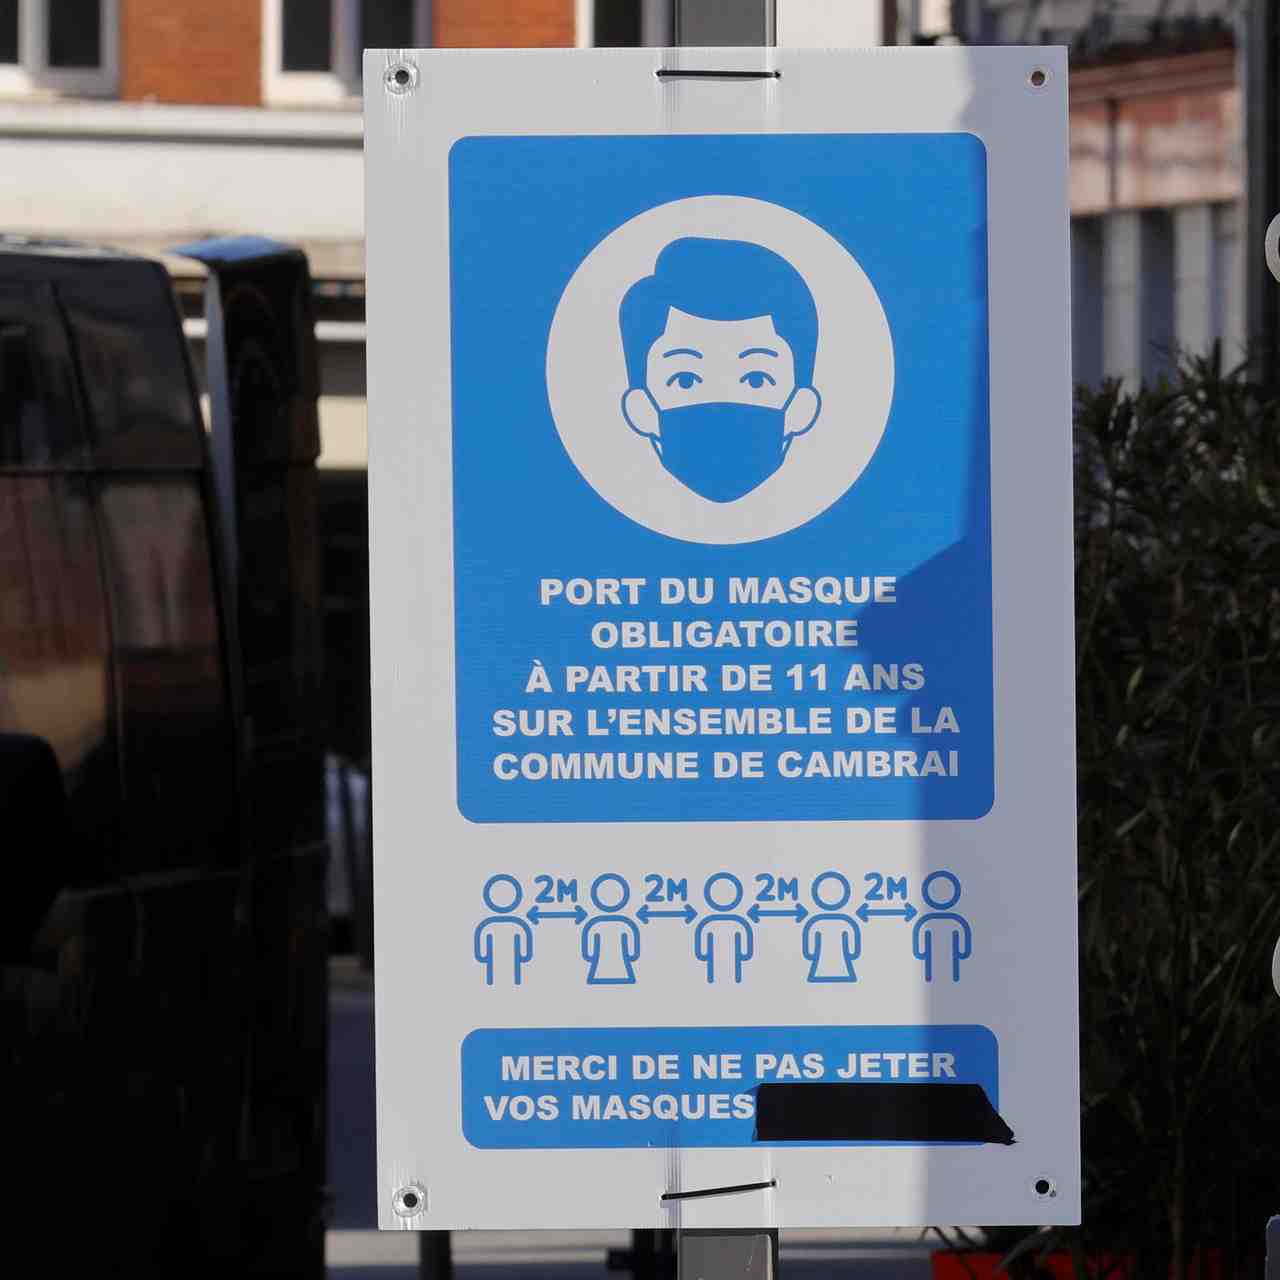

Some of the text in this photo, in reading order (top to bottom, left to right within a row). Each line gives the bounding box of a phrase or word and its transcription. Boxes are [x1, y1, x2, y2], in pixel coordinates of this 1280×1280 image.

[540, 576, 897, 606] PORT DU MASQUE
[591, 620, 858, 649] OBLIGATOIRE
[525, 660, 925, 693] À PARTIR DE 11 ANS
[492, 707, 960, 737] SUR L’ENSEMBLE DE LA
[493, 751, 959, 781] COMMUNE DE CAMBRAI
[533, 875, 578, 903] 2M
[644, 874, 688, 903] 2M
[755, 873, 799, 902] 2M
[863, 872, 908, 902] 2M
[501, 1053, 956, 1081] MERCI DE NE PAS JETER
[484, 1094, 754, 1122] VOS MASQUES
